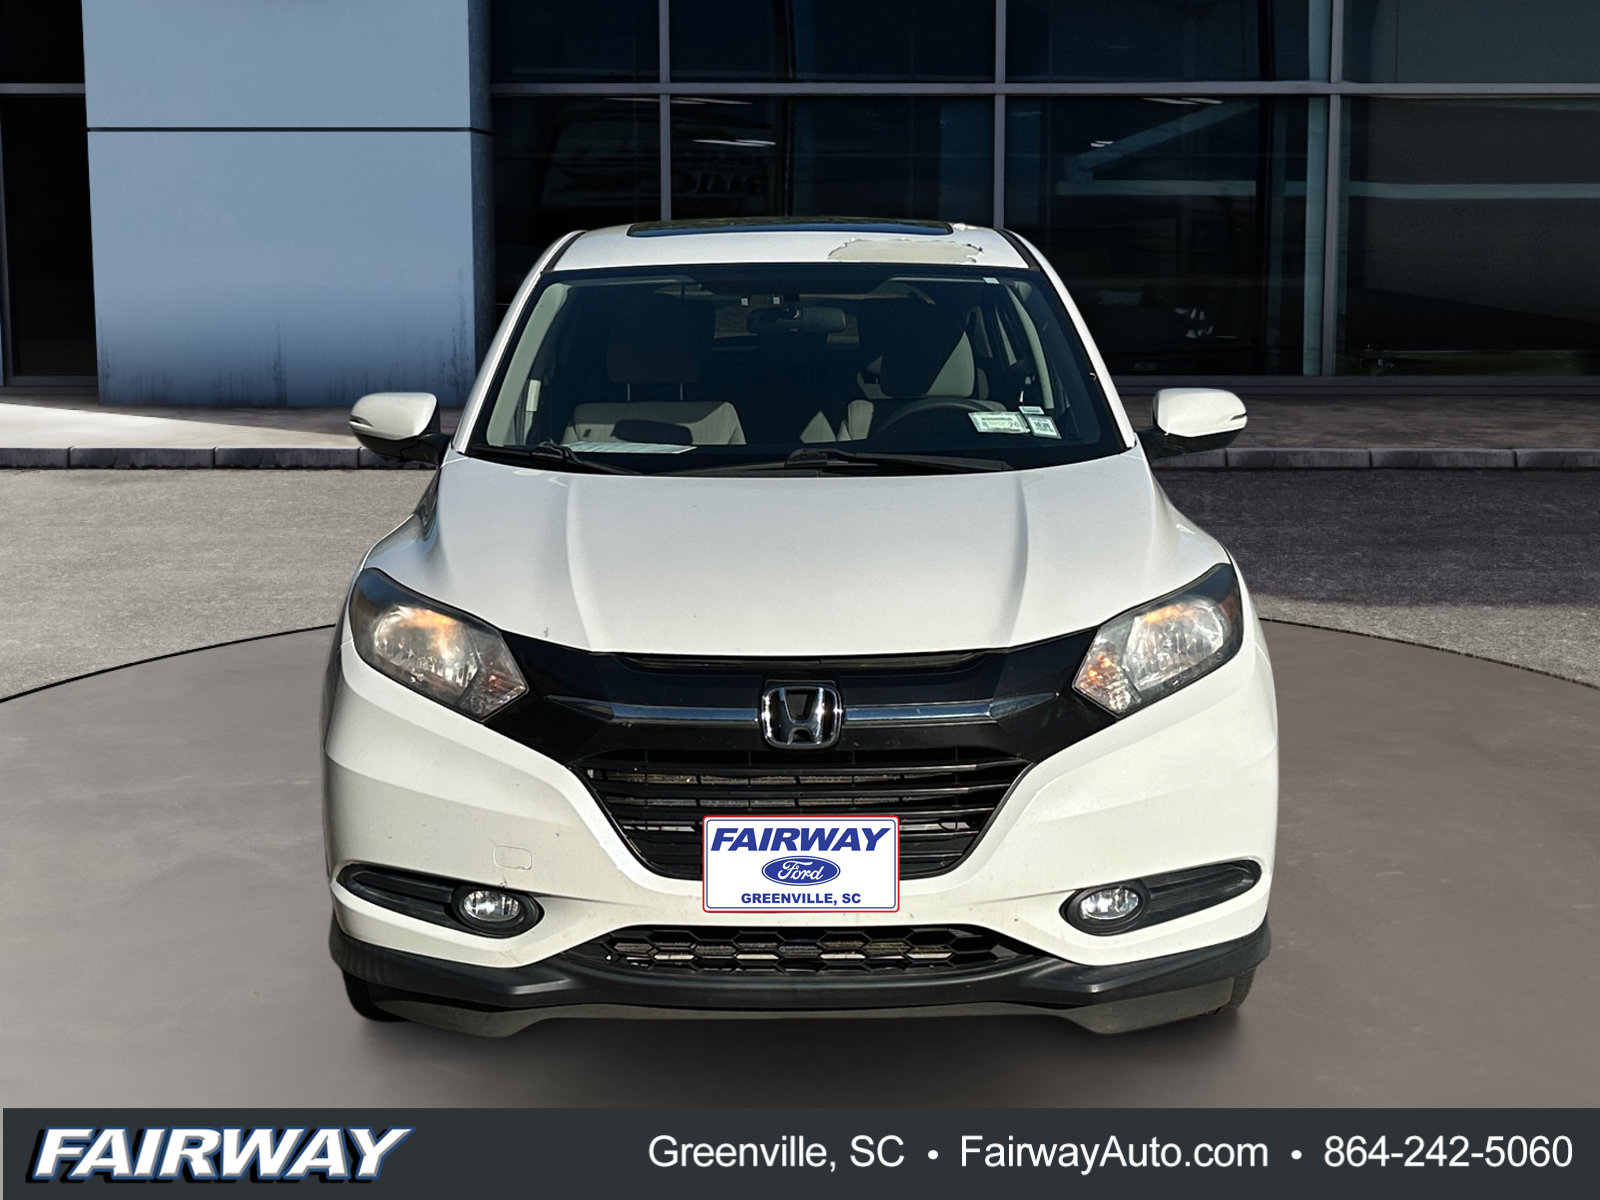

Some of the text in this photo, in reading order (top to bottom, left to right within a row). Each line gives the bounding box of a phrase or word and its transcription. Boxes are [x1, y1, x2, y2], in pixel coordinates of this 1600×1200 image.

[710, 827, 892, 852] FAIRWAY
[777, 860, 825, 880] Ford
[741, 893, 861, 905] GREENVILLE, SC
